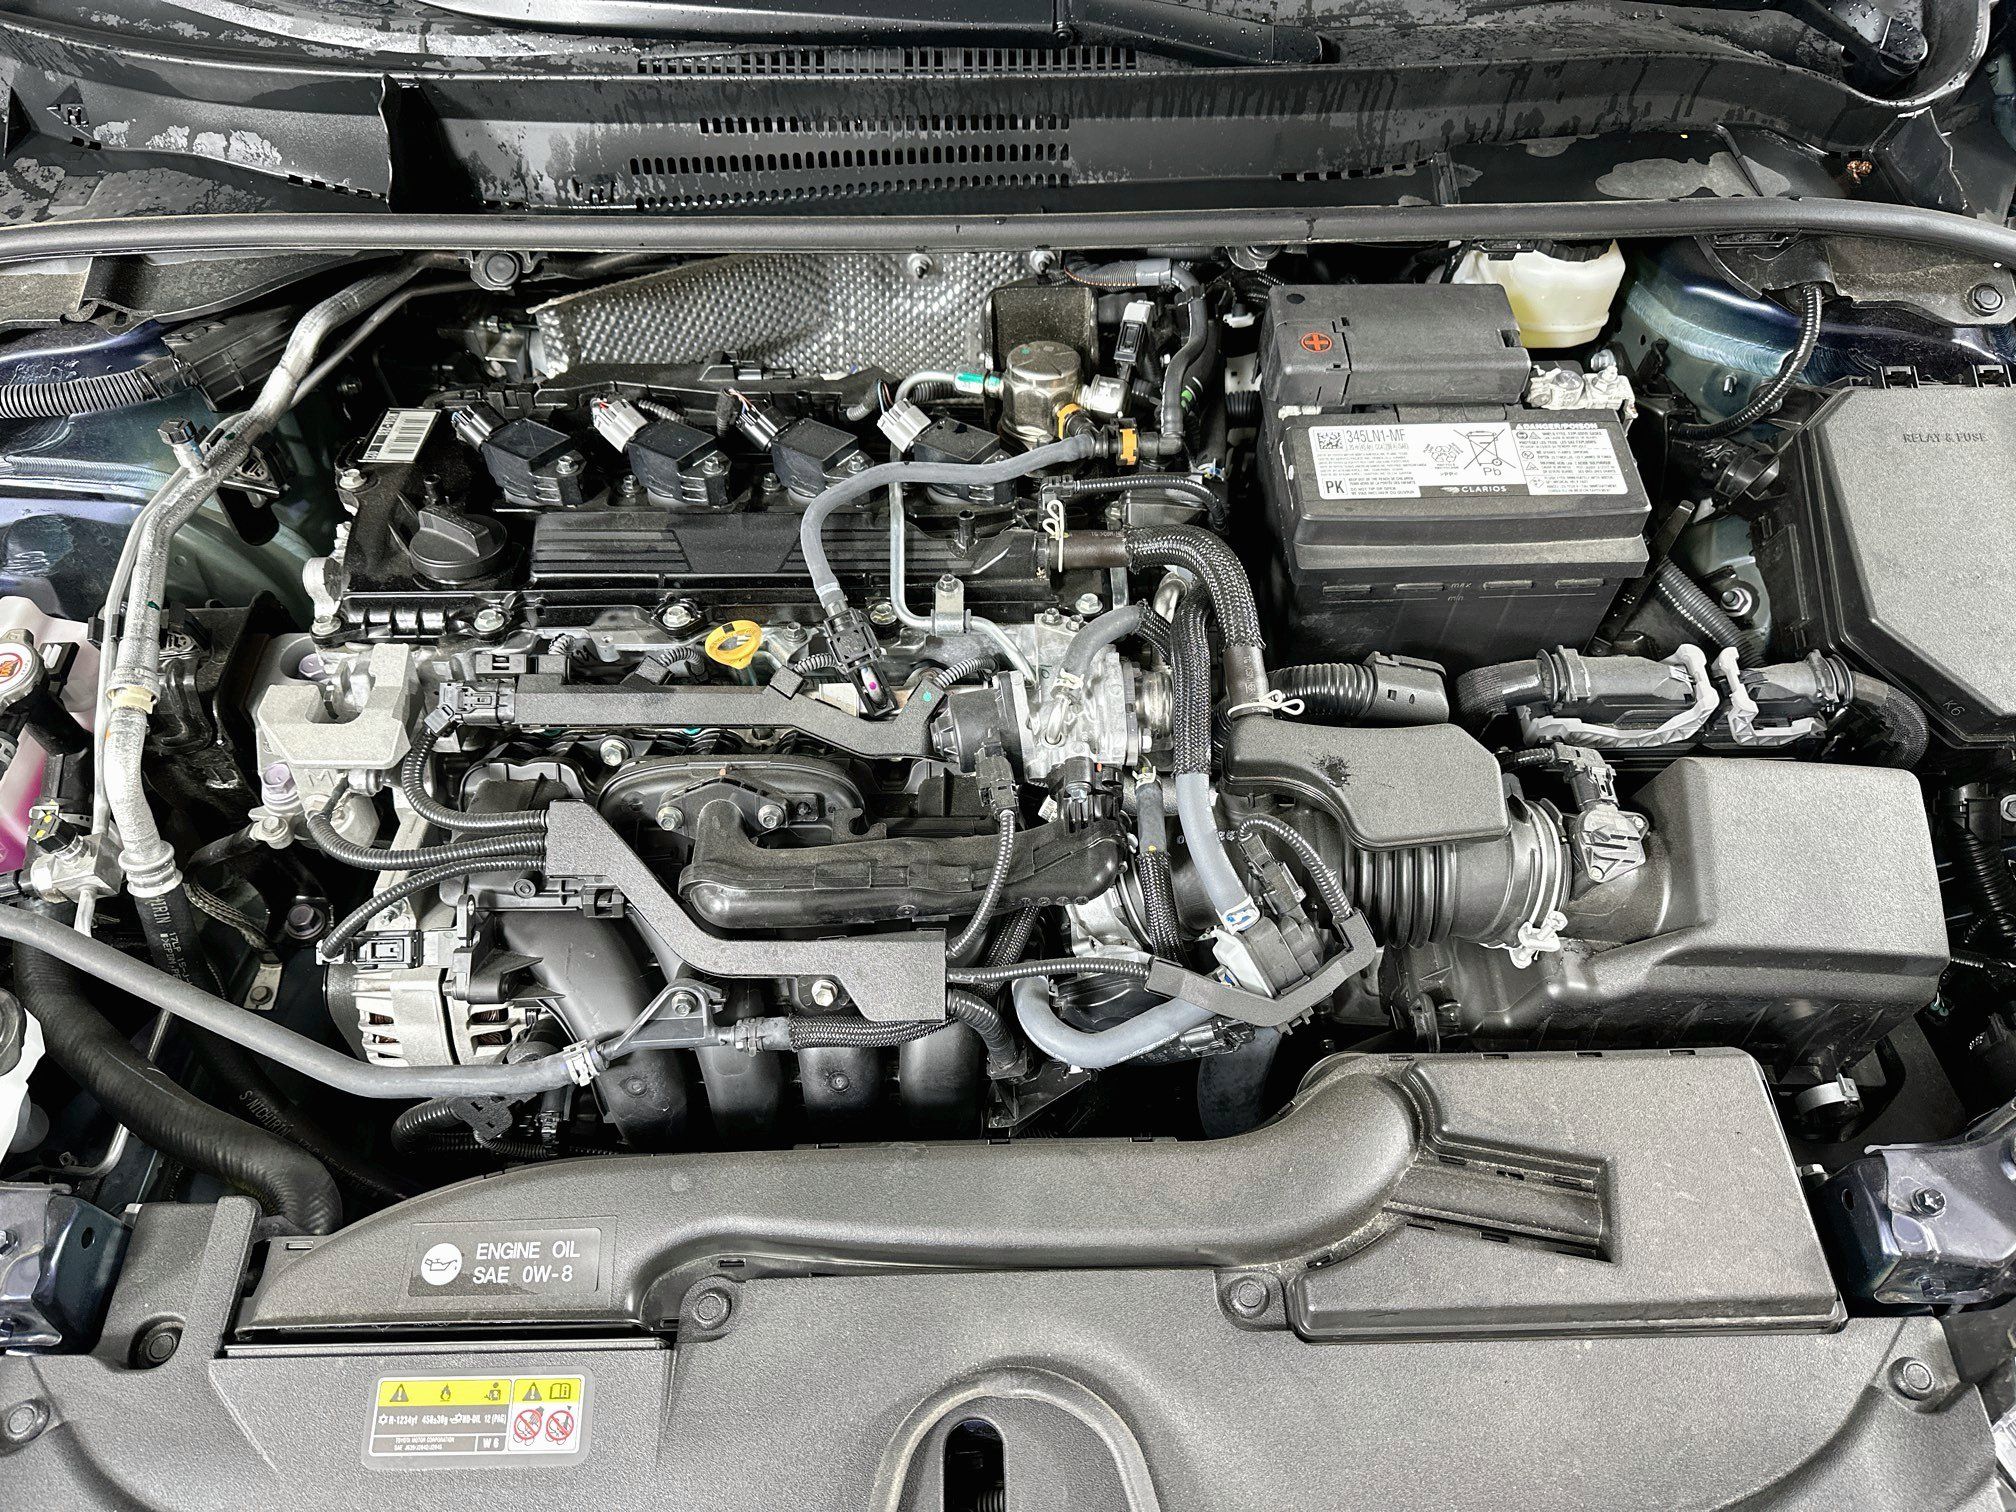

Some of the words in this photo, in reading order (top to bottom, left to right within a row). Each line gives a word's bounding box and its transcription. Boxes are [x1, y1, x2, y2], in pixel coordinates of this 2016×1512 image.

[1346, 429, 1405, 443] 345LN1-MF
[1902, 433, 1941, 443] RELAY
[1945, 433, 1952, 442] &
[1956, 432, 1987, 442] FUSE
[1483, 467, 1502, 476] Pb
[1325, 480, 1345, 494] PK
[1461, 485, 1507, 493] CLARIOS
[1942, 699, 1966, 716] K6
[475, 1241, 541, 1260] ENGINE
[552, 1240, 581, 1258] OIL
[472, 1266, 510, 1284] SAE
[522, 1264, 573, 1283] 0W-8
[388, 1414, 418, 1426] R-1234yf
[484, 1414, 491, 1423] 12
